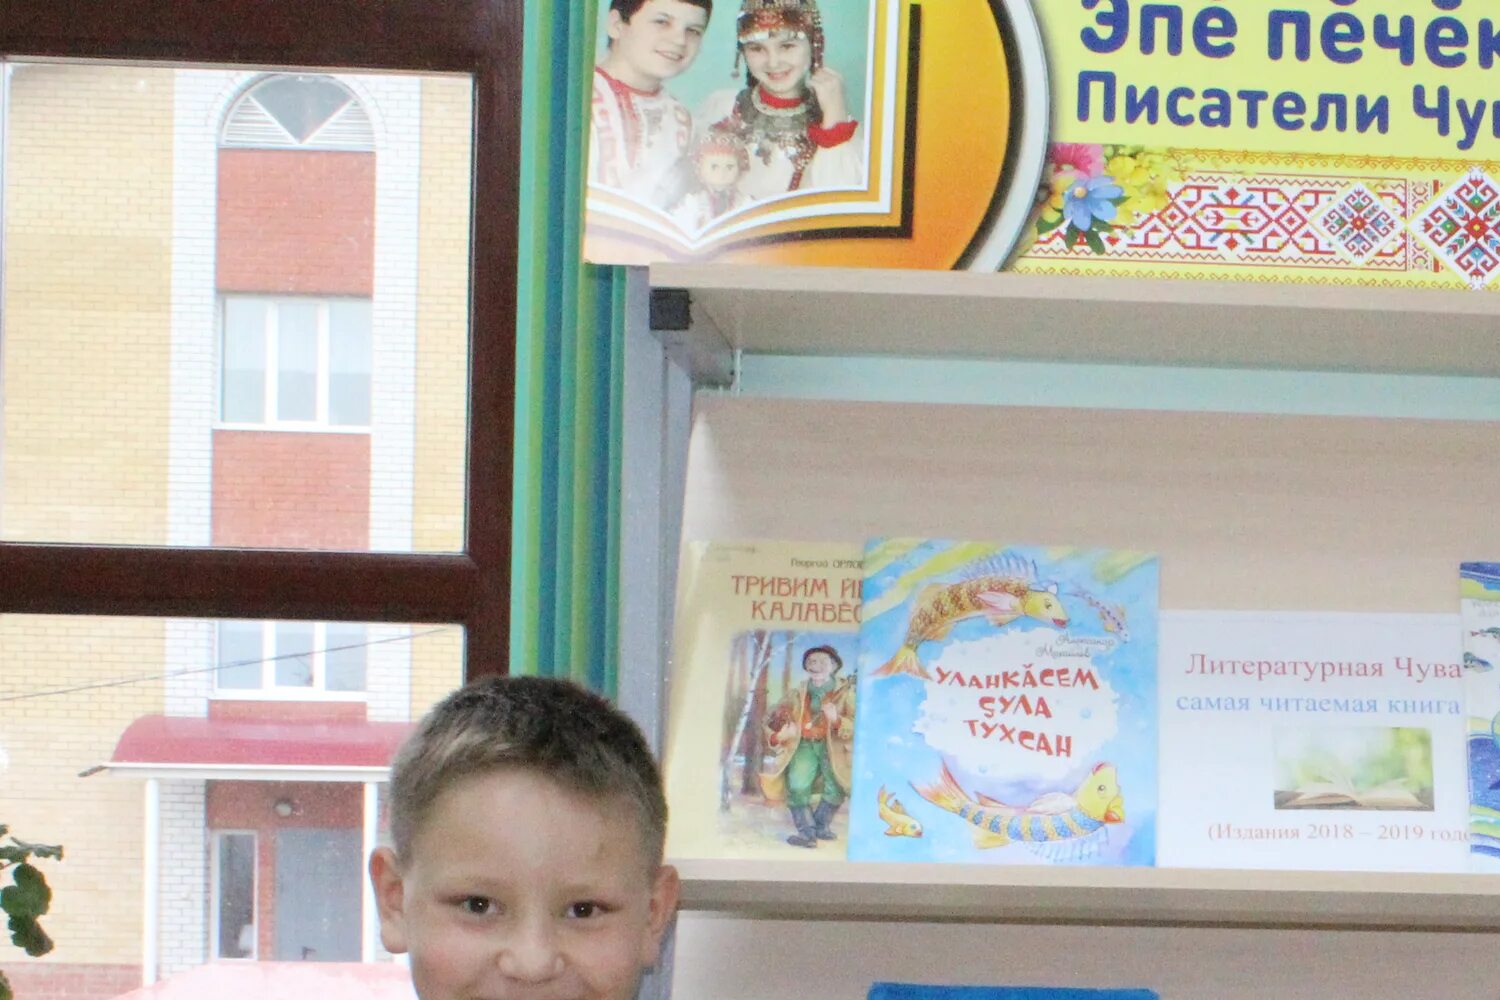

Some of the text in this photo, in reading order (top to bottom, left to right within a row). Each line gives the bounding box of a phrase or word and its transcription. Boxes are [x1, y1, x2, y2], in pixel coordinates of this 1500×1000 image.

[1077, 70, 1390, 135] Писатели
[731, 575, 829, 598] ТРИВИМ
[1185, 654, 1383, 682] Литературная
[1175, 695, 1461, 715] самая читаемая книга
[963, 720, 1072, 758] ТУХСАН
[1207, 823, 1300, 841] (Издания
[1307, 824, 1354, 840] 2018
[1376, 825, 1424, 841] 2019
